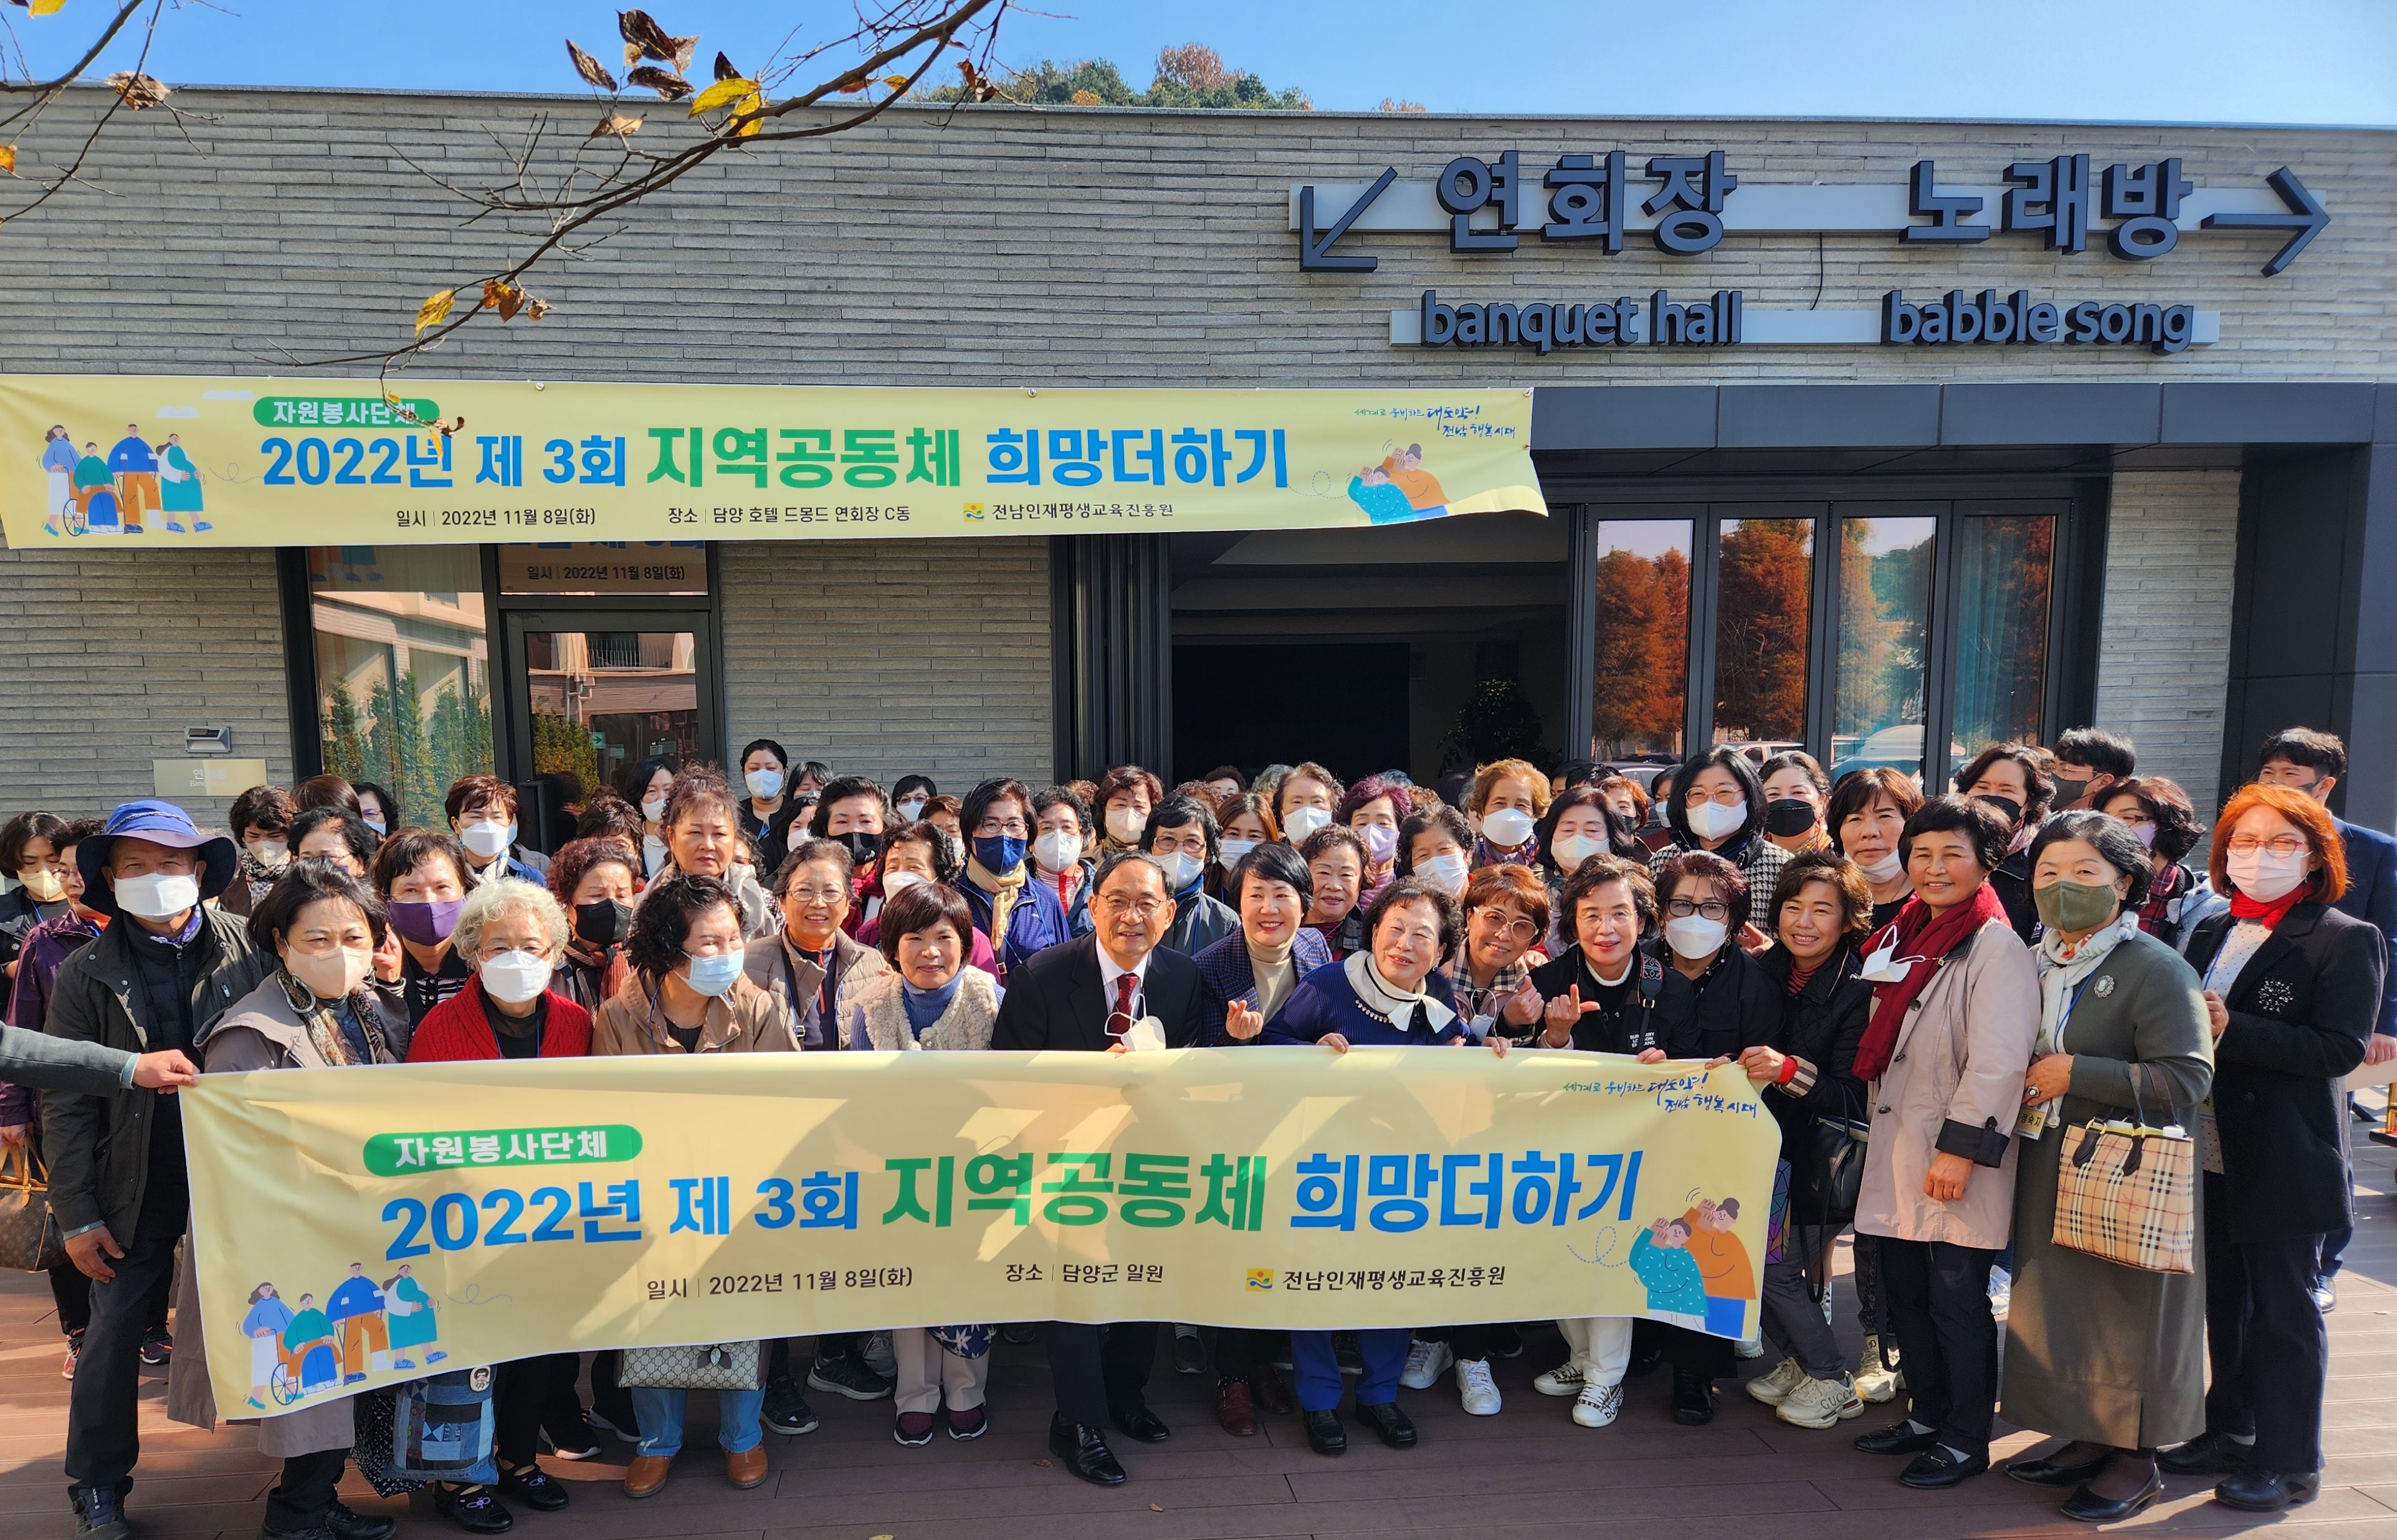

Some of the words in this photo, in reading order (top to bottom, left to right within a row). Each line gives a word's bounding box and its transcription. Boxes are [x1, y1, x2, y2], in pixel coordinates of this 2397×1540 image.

[1437, 150, 1738, 257] 연회장
[1899, 153, 2193, 261] 노래방
[1421, 290, 1638, 356] banquet
[1650, 290, 1742, 347] hall
[1880, 289, 2058, 347] babble
[2065, 300, 2194, 356] song
[1355, 408, 1386, 416] 세계로
[1389, 408, 1424, 421] 웅비하는
[1427, 405, 1480, 430] 대도약!
[1442, 424, 1467, 437] 전남
[260, 434, 453, 488] 2022년
[475, 435, 522, 487] 제
[543, 434, 626, 487] 3회
[647, 427, 961, 489] 지역공동체
[986, 428, 1289, 488] 희망더하기
[396, 510, 426, 527] 일시
[442, 509, 497, 526] 2022년
[503, 509, 537, 525] 11월
[543, 508, 595, 525] 8일(화)
[668, 508, 698, 524] 장소
[713, 507, 743, 523] 담양
[749, 506, 778, 523] 호텔
[784, 507, 829, 523] 드몽드
[835, 506, 880, 522] 연회장
[885, 506, 910, 521] C동
[992, 503, 1173, 520] 전남인재평생교육진흥원
[528, 566, 552, 579] 일시
[563, 566, 608, 580] 2022년
[612, 566, 639, 580] 11월
[644, 566, 685, 580] 8일(화)
[1563, 1082, 1601, 1092] 세계로
[1604, 1081, 1646, 1098] 웅비하는
[1647, 1072, 1709, 1106] 대도약!
[1664, 1096, 1689, 1113] 전남
[394, 1130, 608, 1168] 자원봉사단체
[381, 1176, 642, 1260] 2022년
[669, 1176, 730, 1235] 제
[755, 1171, 859, 1230] 3회
[883, 1153, 1267, 1232] 지역공동체
[1290, 1150, 1644, 1233] 희망더하기
[647, 1278, 687, 1300] 일시
[709, 1273, 783, 1295] 2022년
[793, 1270, 836, 1291] 11월
[845, 1267, 912, 1288] 8일(화)
[1006, 1263, 1043, 1282] 장소
[1063, 1264, 1119, 1284] 담양군
[1127, 1263, 1163, 1283] 일원
[1282, 1266, 1505, 1291] 전남인재평생교육진흥원
